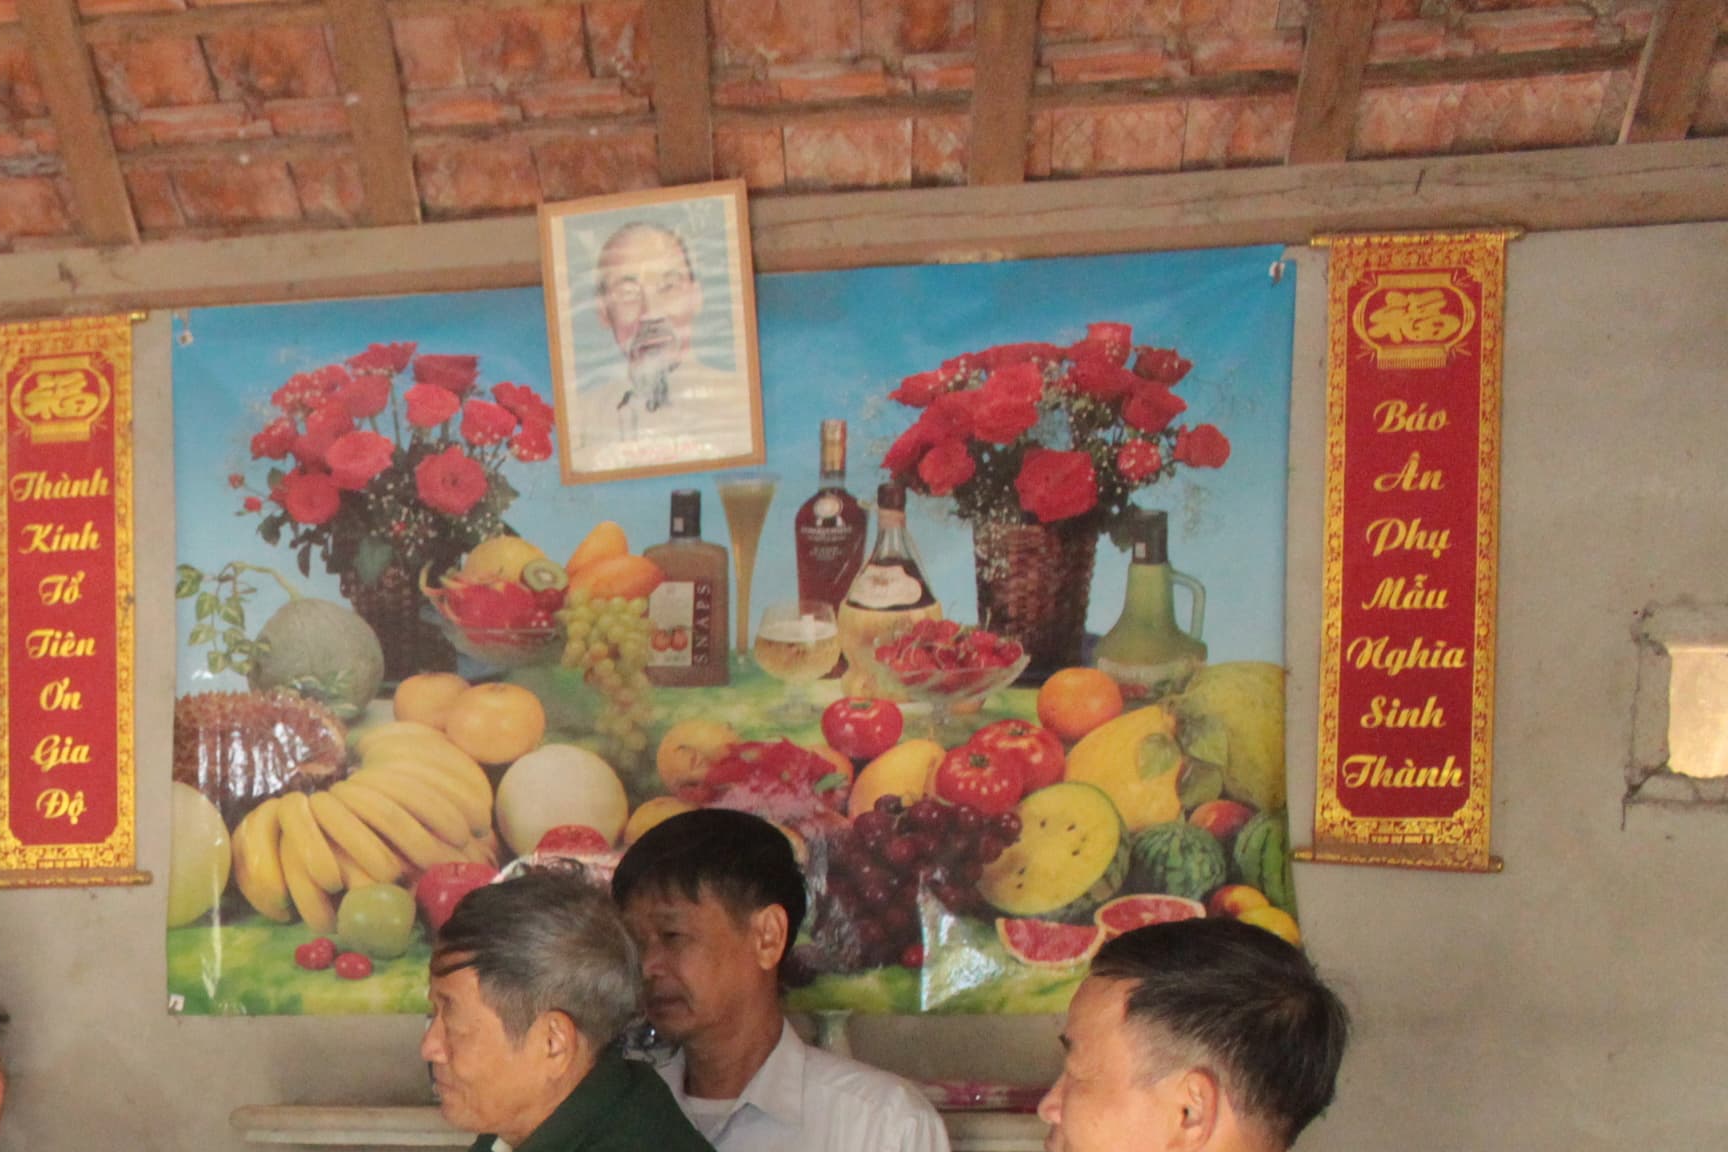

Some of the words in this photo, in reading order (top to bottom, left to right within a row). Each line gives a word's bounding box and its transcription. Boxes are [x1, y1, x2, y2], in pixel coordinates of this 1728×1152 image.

[1374, 400, 1447, 432] Báo
[9, 468, 108, 501] Thành
[1366, 518, 1450, 558] Phụ
[696, 585, 711, 664] SNAPS
[28, 629, 95, 658] Tiên
[40, 677, 81, 710] Ơn
[1360, 696, 1443, 728] Sinh
[32, 735, 90, 772] Gia
[1342, 755, 1462, 787] Thành
[36, 789, 86, 824] Độ
